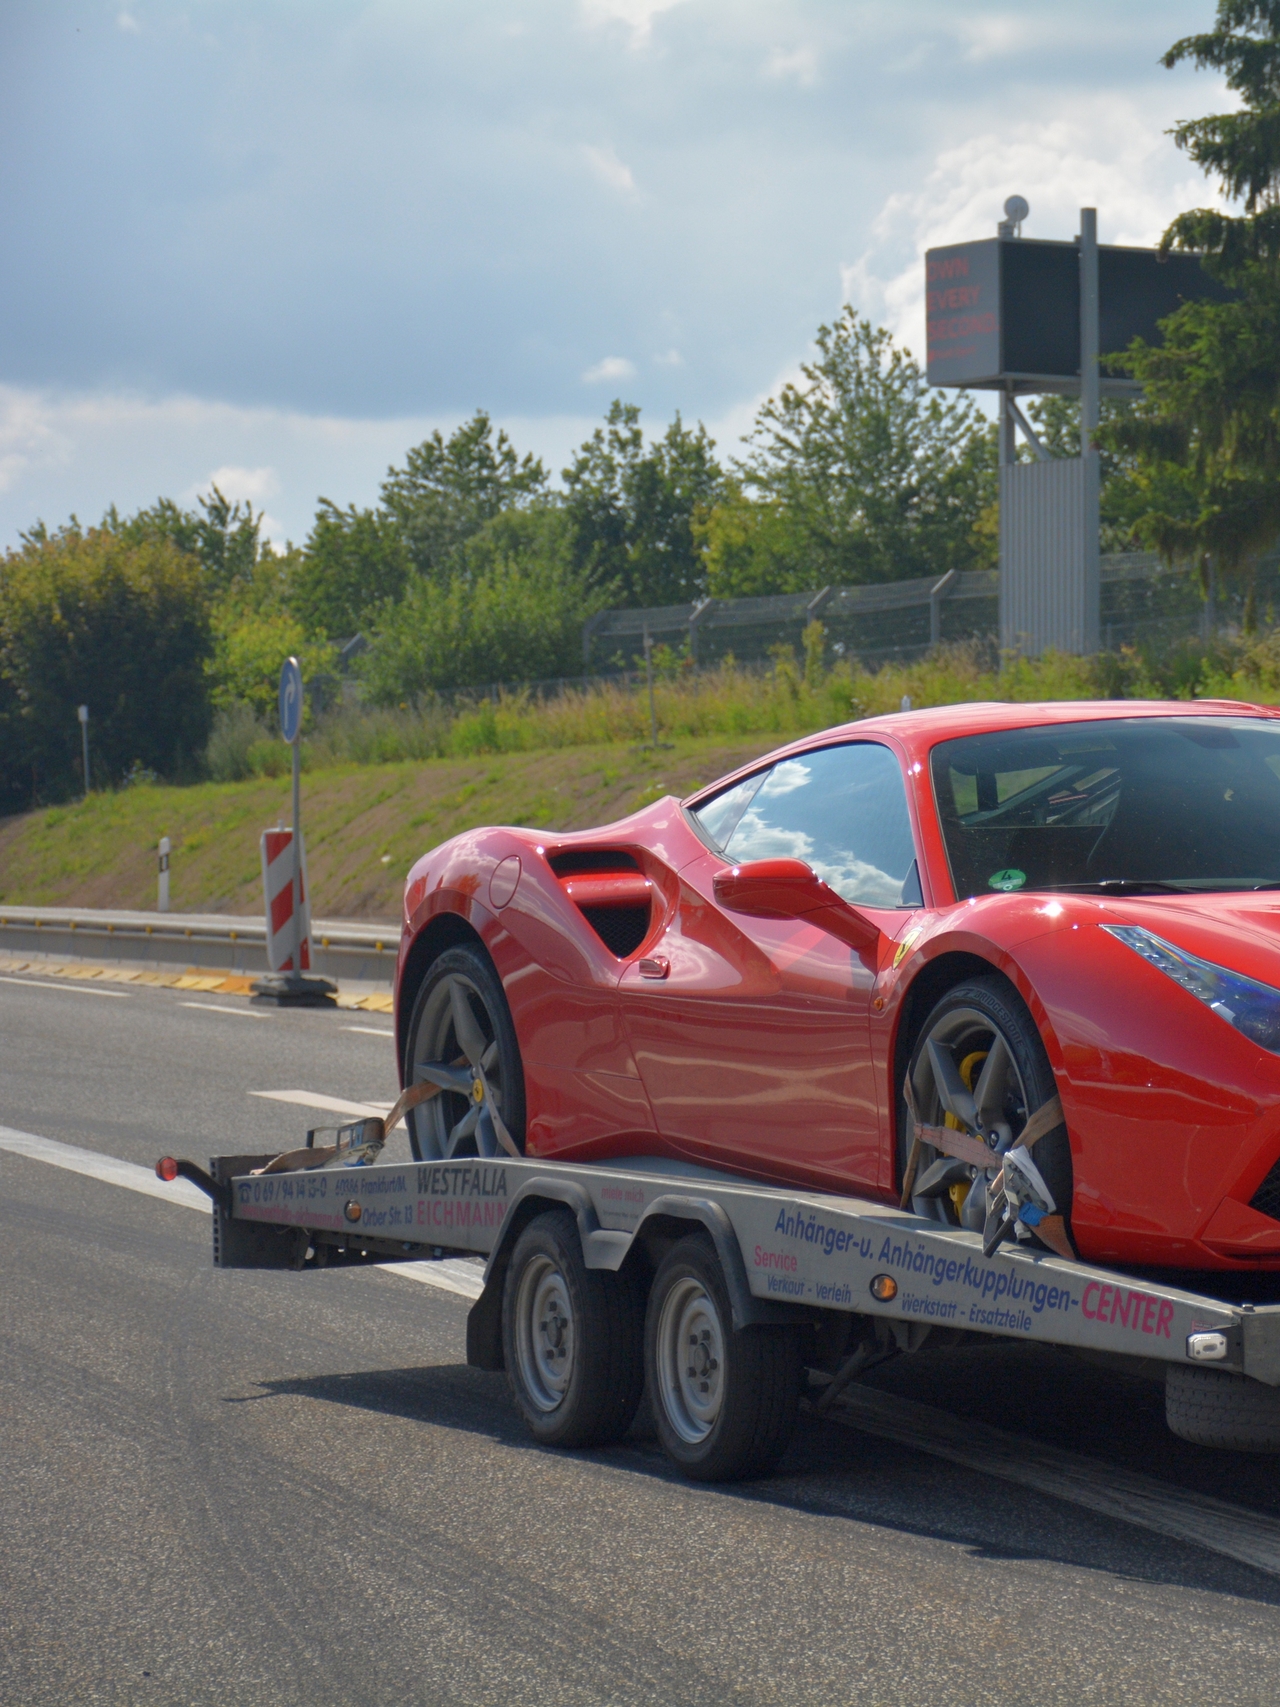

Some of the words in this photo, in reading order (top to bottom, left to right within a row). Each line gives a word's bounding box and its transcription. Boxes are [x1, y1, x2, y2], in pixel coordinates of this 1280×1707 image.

[926, 285, 981, 311] EVERY
[1001, 870, 1012, 880] 4
[974, 990, 1024, 1048] BRIDGESTONE
[417, 1167, 507, 1196] WESTFALIA
[754, 1245, 798, 1272] Service
[968, 1302, 1033, 1332] Ersatzteile
